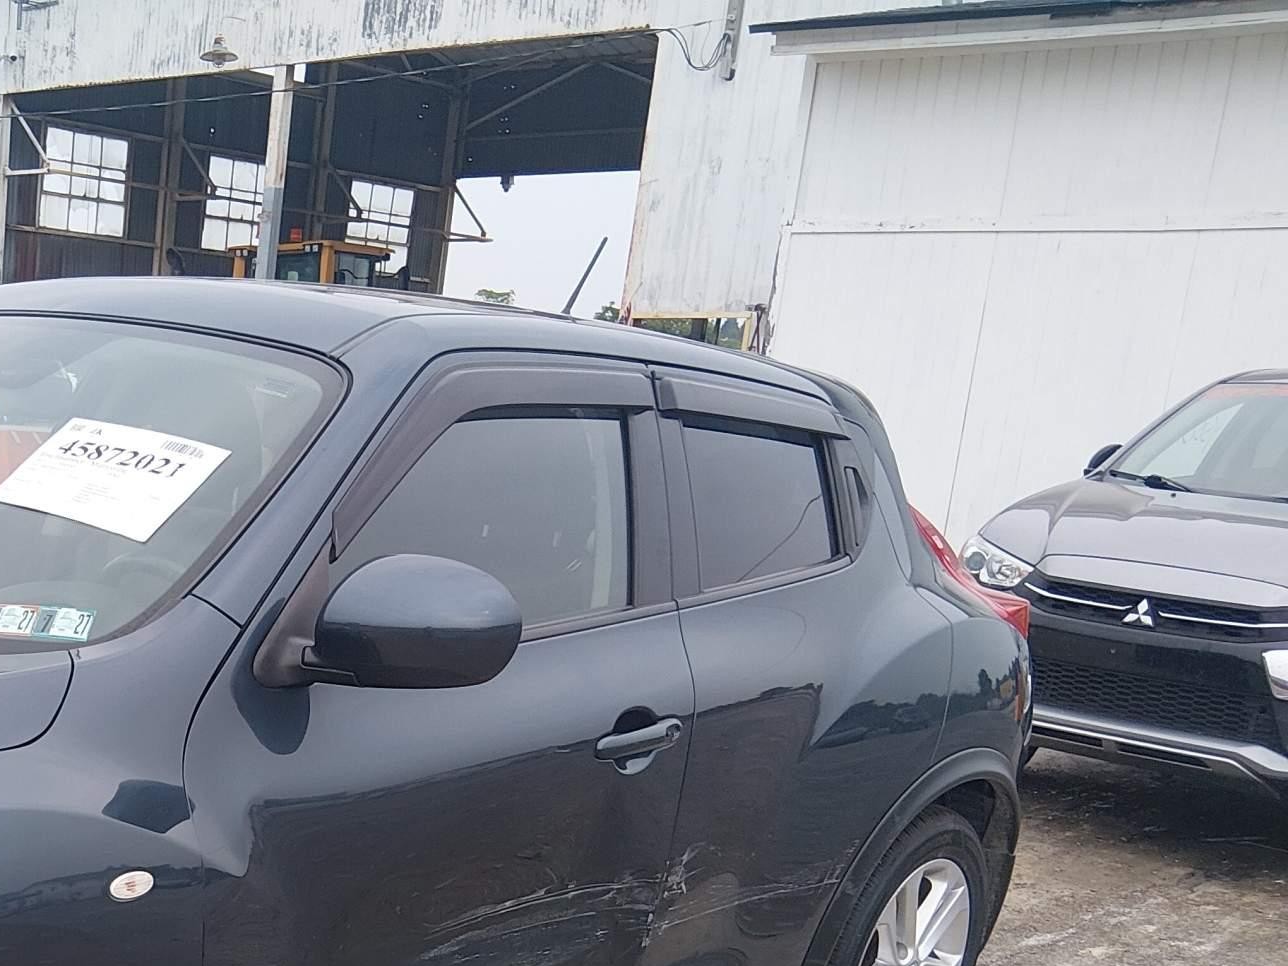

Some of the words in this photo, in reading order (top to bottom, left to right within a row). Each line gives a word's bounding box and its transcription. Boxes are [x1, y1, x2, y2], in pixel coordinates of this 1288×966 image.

[59, 439, 186, 478] 45872021
[17, 610, 35, 632] 27
[73, 614, 91, 636] 27
